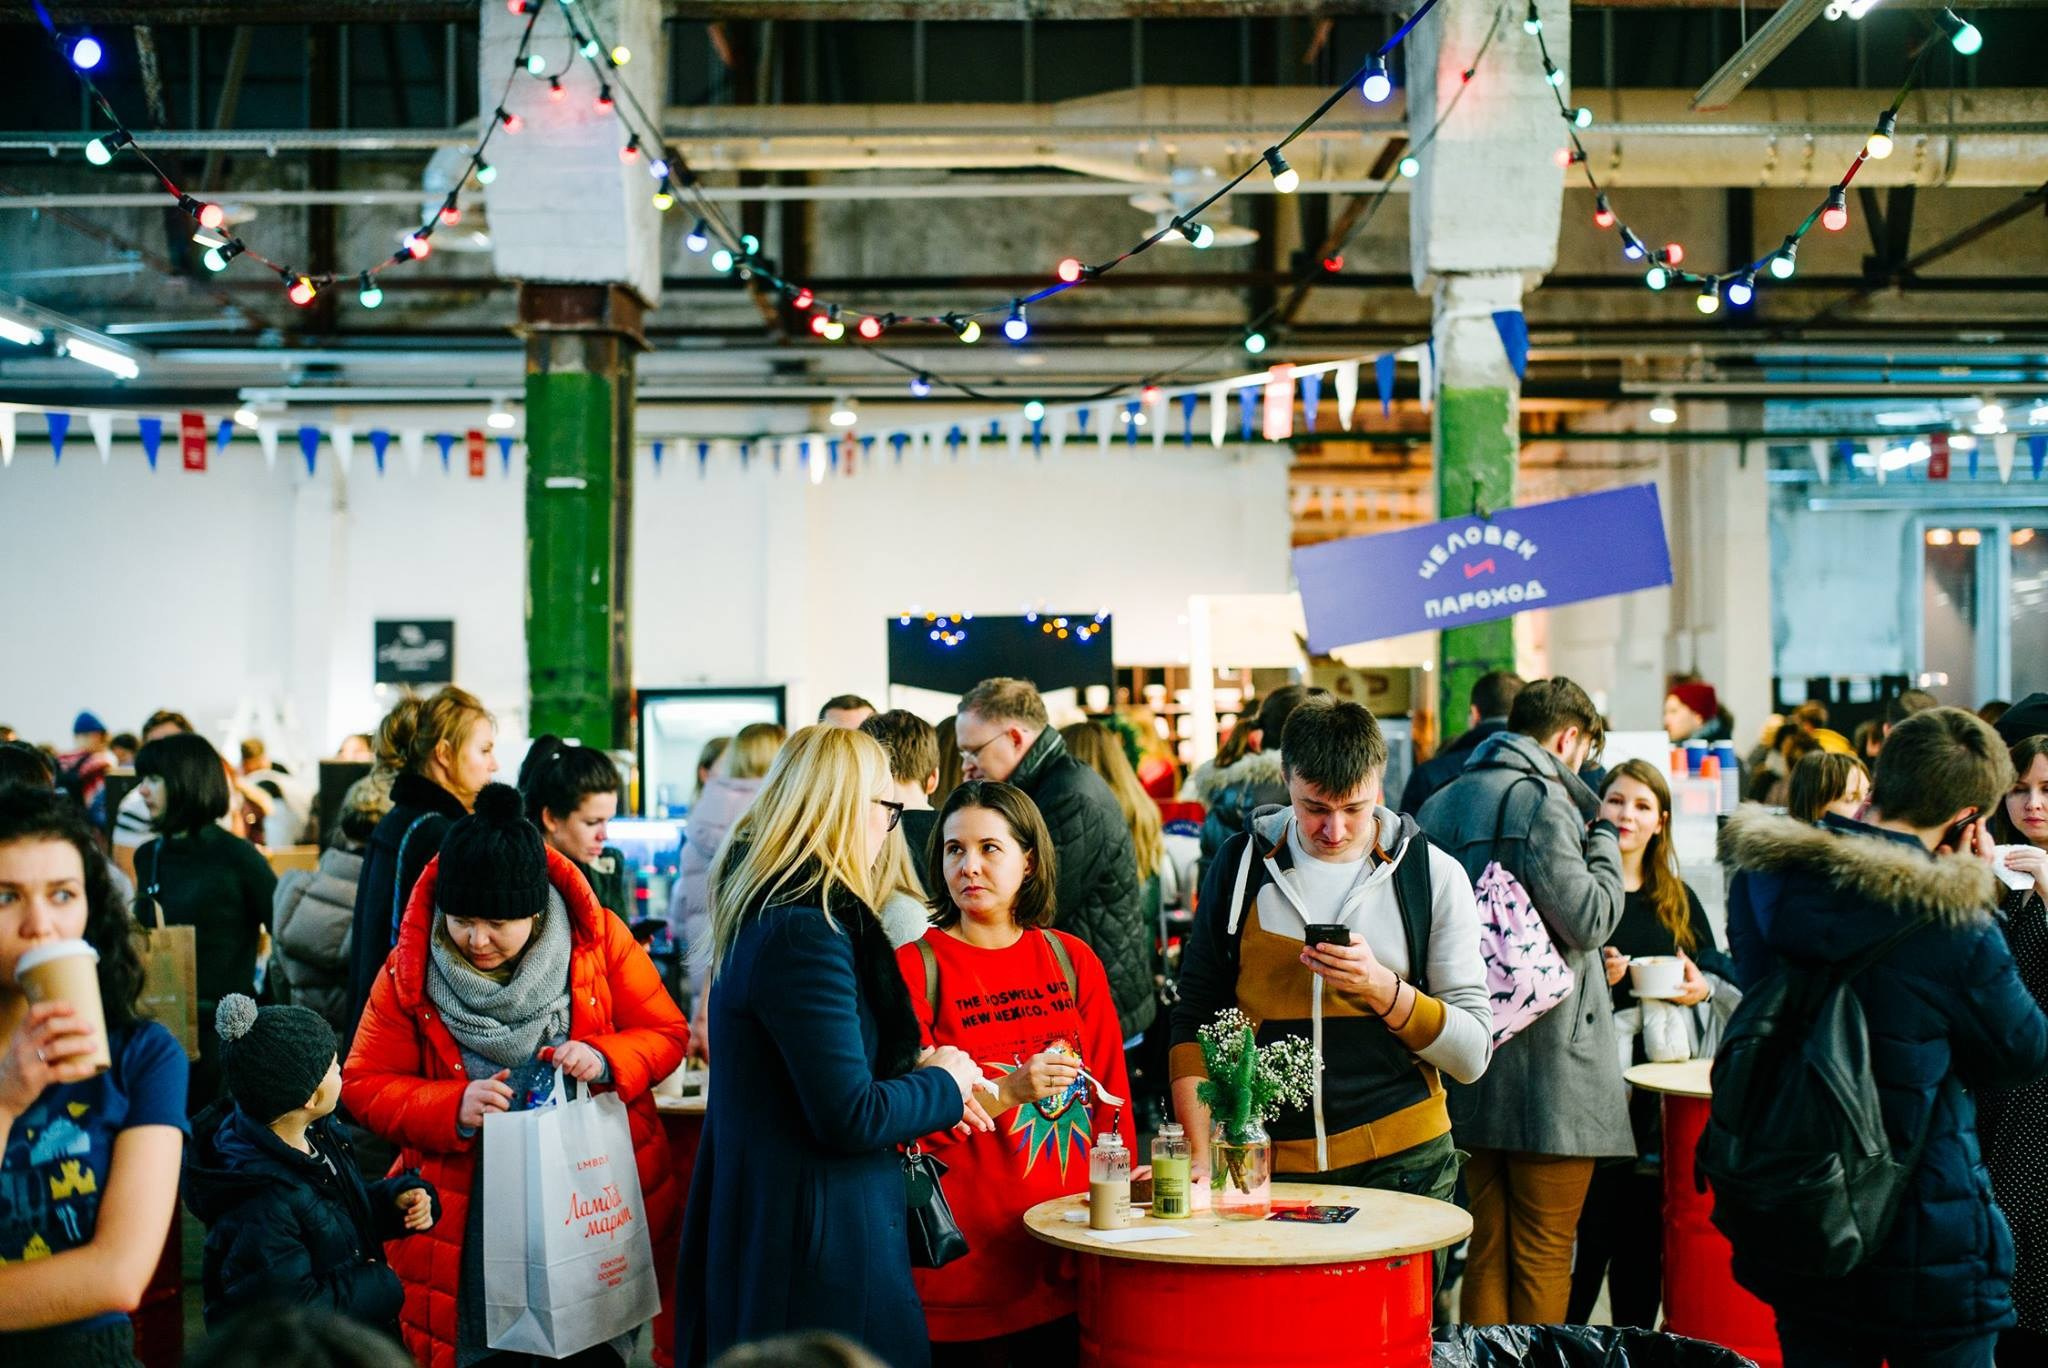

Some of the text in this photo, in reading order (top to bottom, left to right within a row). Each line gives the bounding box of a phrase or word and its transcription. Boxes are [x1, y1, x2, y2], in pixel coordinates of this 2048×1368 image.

[1418, 525, 1538, 580] ЧЕЛОВЕК
[1424, 579, 1548, 619] ПАРОХОД
[956, 996, 981, 1011] THE
[961, 1012, 990, 1029] NEW
